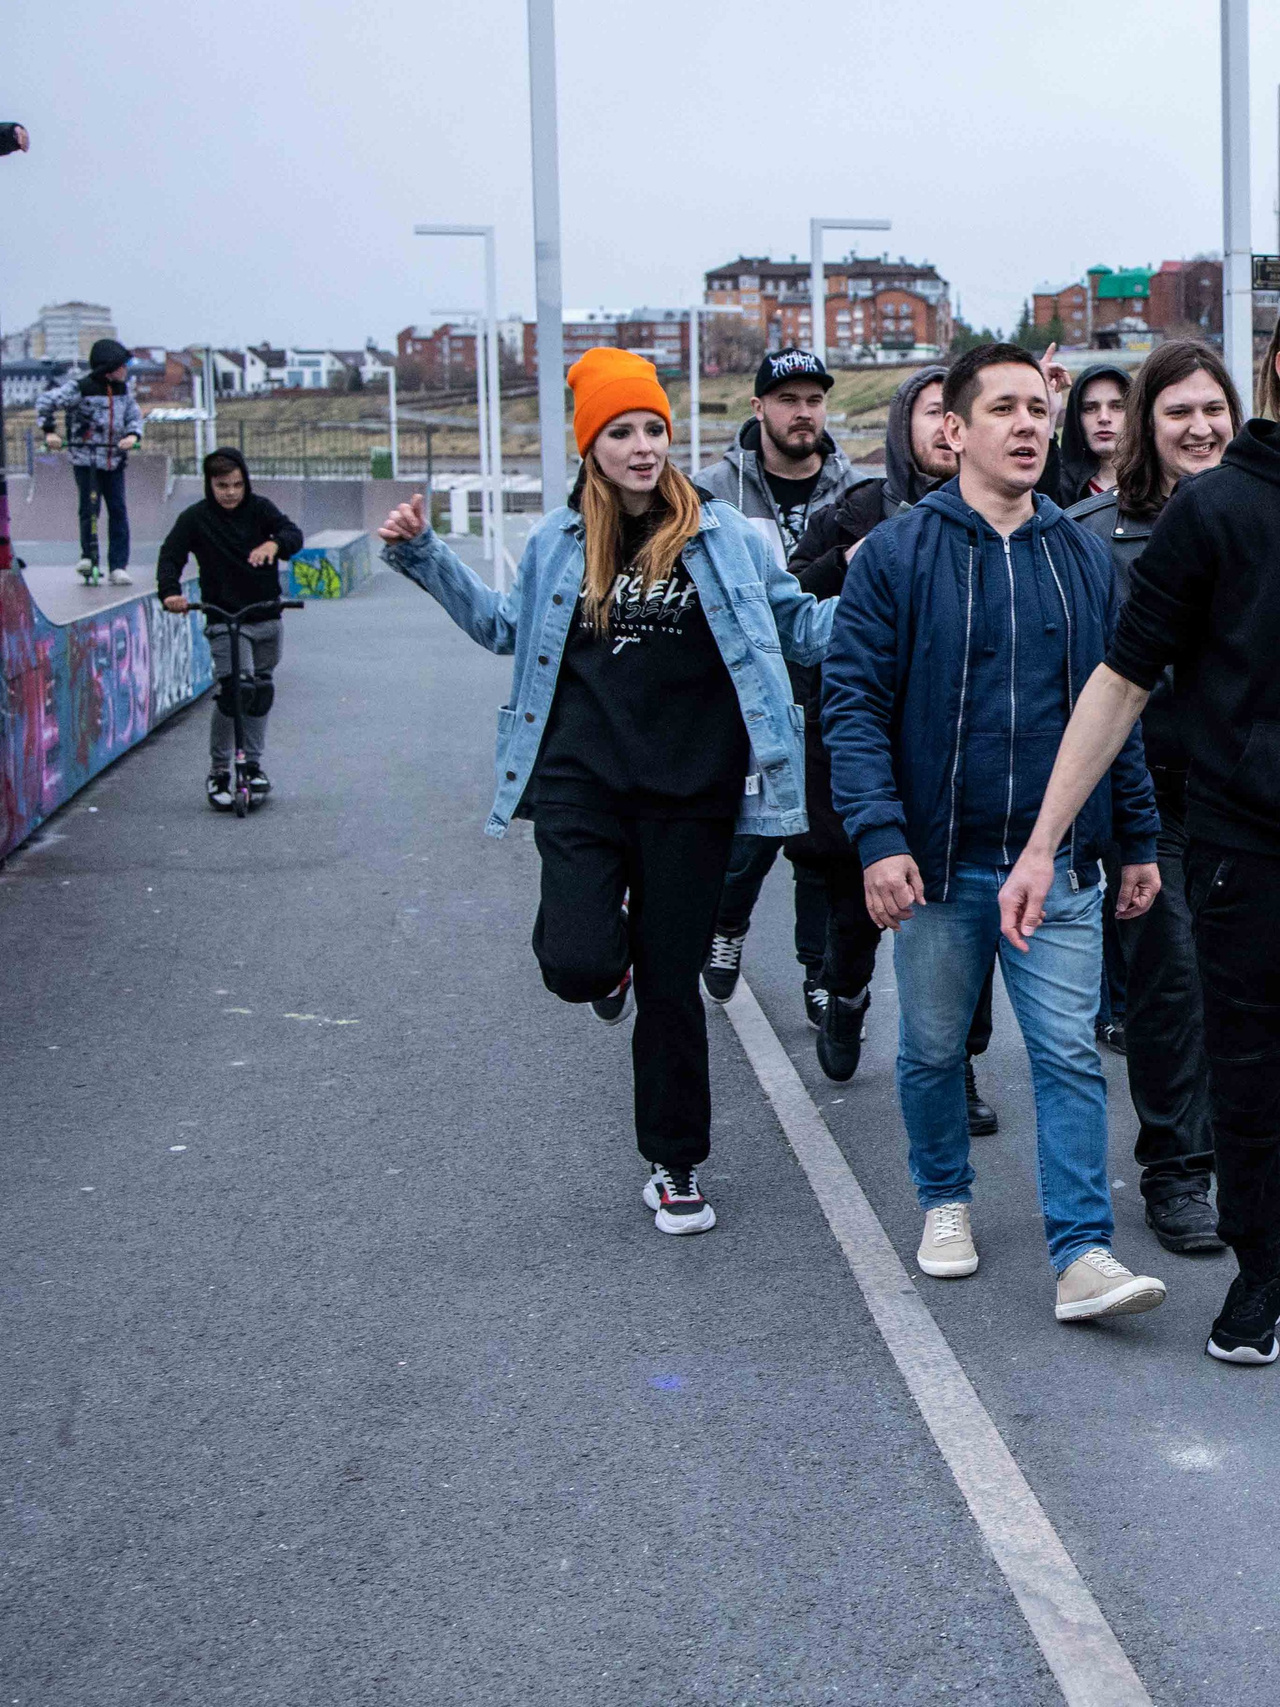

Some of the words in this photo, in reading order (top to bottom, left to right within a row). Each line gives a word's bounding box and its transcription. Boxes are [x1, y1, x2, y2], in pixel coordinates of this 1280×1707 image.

[613, 623, 655, 632] YOU'RE
[661, 626, 683, 635] YOU
[612, 632, 642, 655] again
